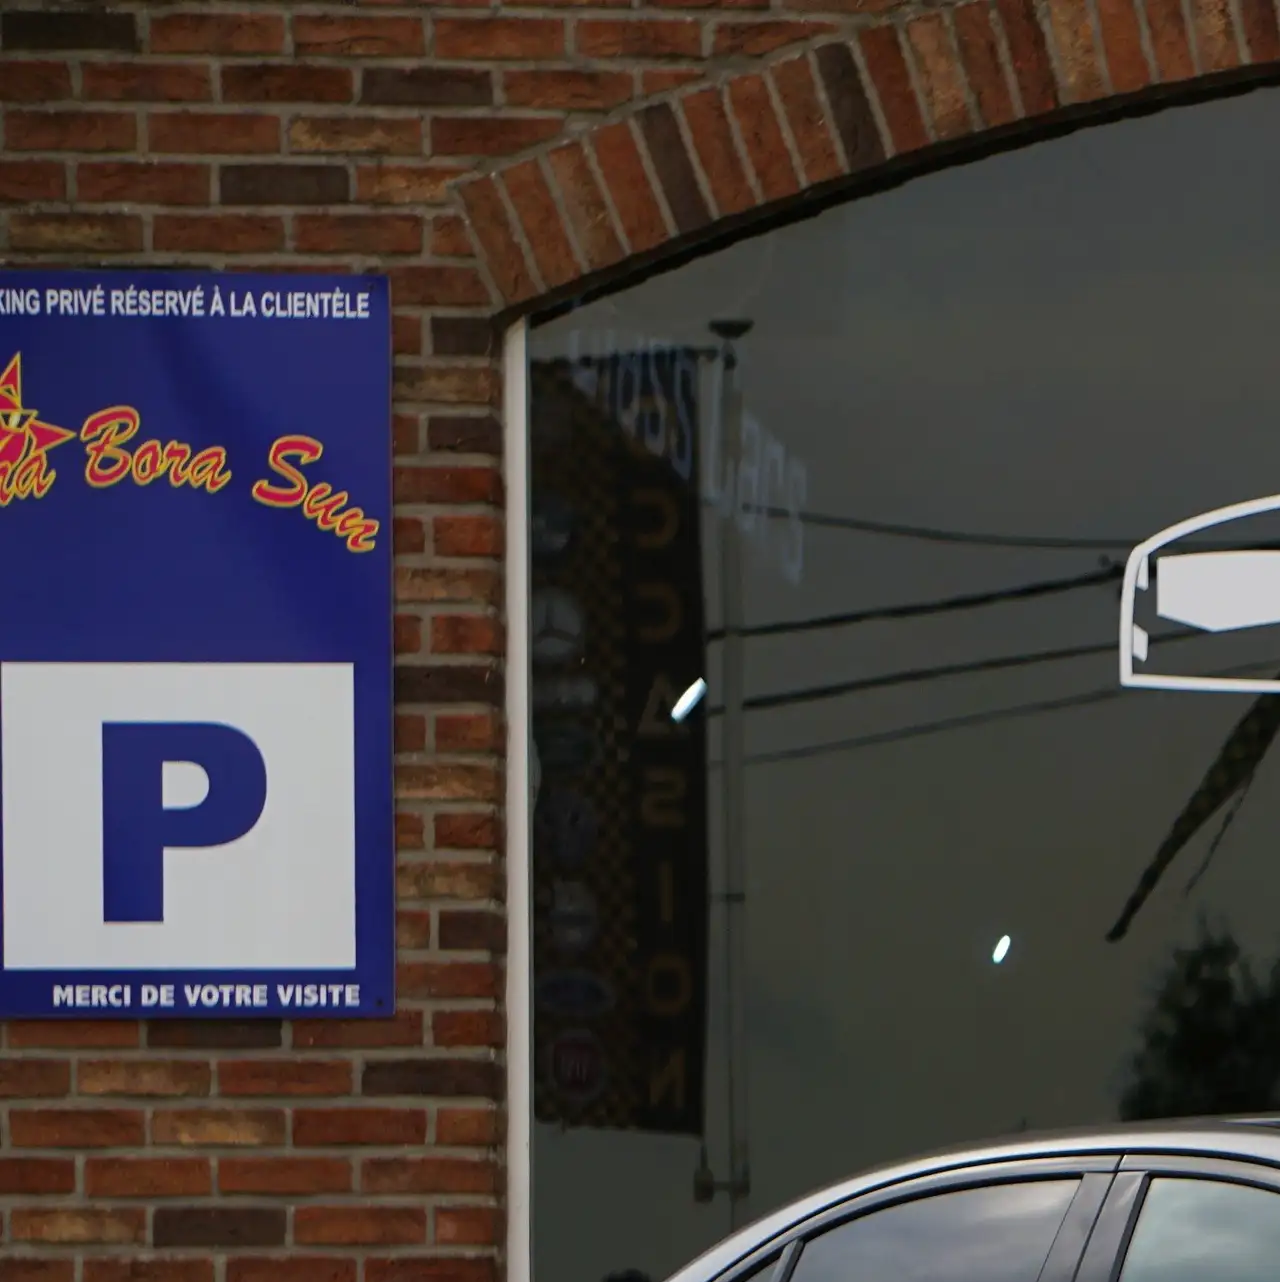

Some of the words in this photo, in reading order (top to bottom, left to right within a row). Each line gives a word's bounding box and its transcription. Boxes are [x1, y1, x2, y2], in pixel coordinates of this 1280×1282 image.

[46, 284, 105, 315] PRIVÉ
[111, 284, 205, 316] RÉSERVÉ
[209, 286, 225, 317] À
[230, 291, 257, 317] LA
[260, 286, 370, 318] CLIENTÈLE
[79, 405, 232, 493] Bora
[252, 435, 380, 553] Sun
[102, 721, 267, 923] P
[53, 984, 131, 1007] MERCI
[141, 984, 174, 1007] DE
[184, 984, 268, 1007] VOTRE
[277, 984, 360, 1007] VISITE
